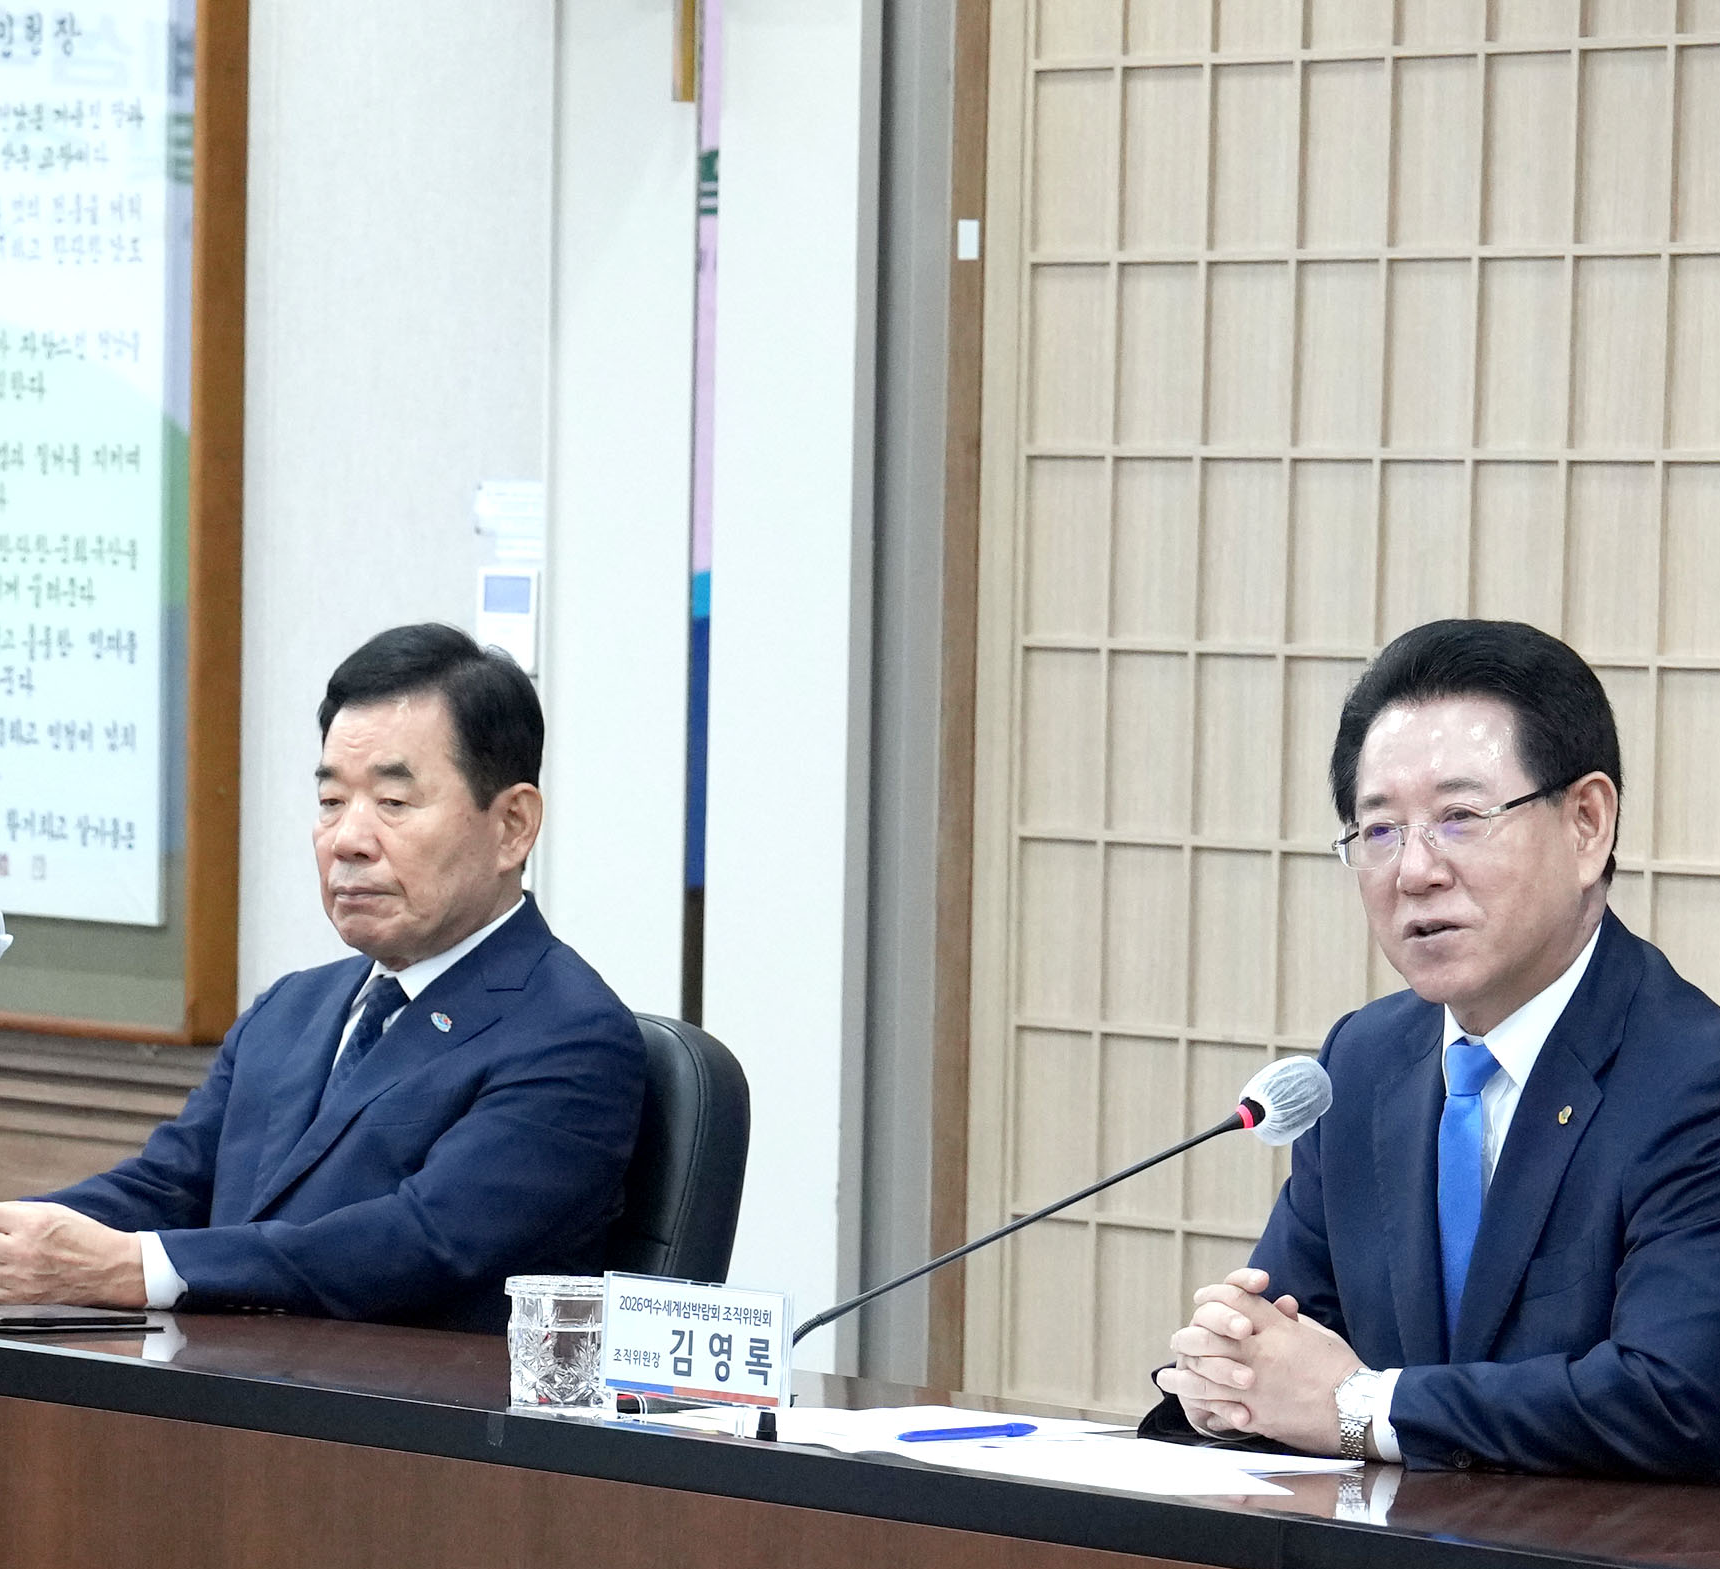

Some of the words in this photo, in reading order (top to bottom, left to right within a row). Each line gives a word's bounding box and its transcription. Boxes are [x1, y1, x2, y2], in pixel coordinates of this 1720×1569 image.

[619, 1295, 721, 1322] 2026여수세계섬박람회
[722, 1301, 773, 1328] 조직위원회
[612, 1347, 661, 1369] 조직위원장
[669, 1328, 773, 1386] 김영록
